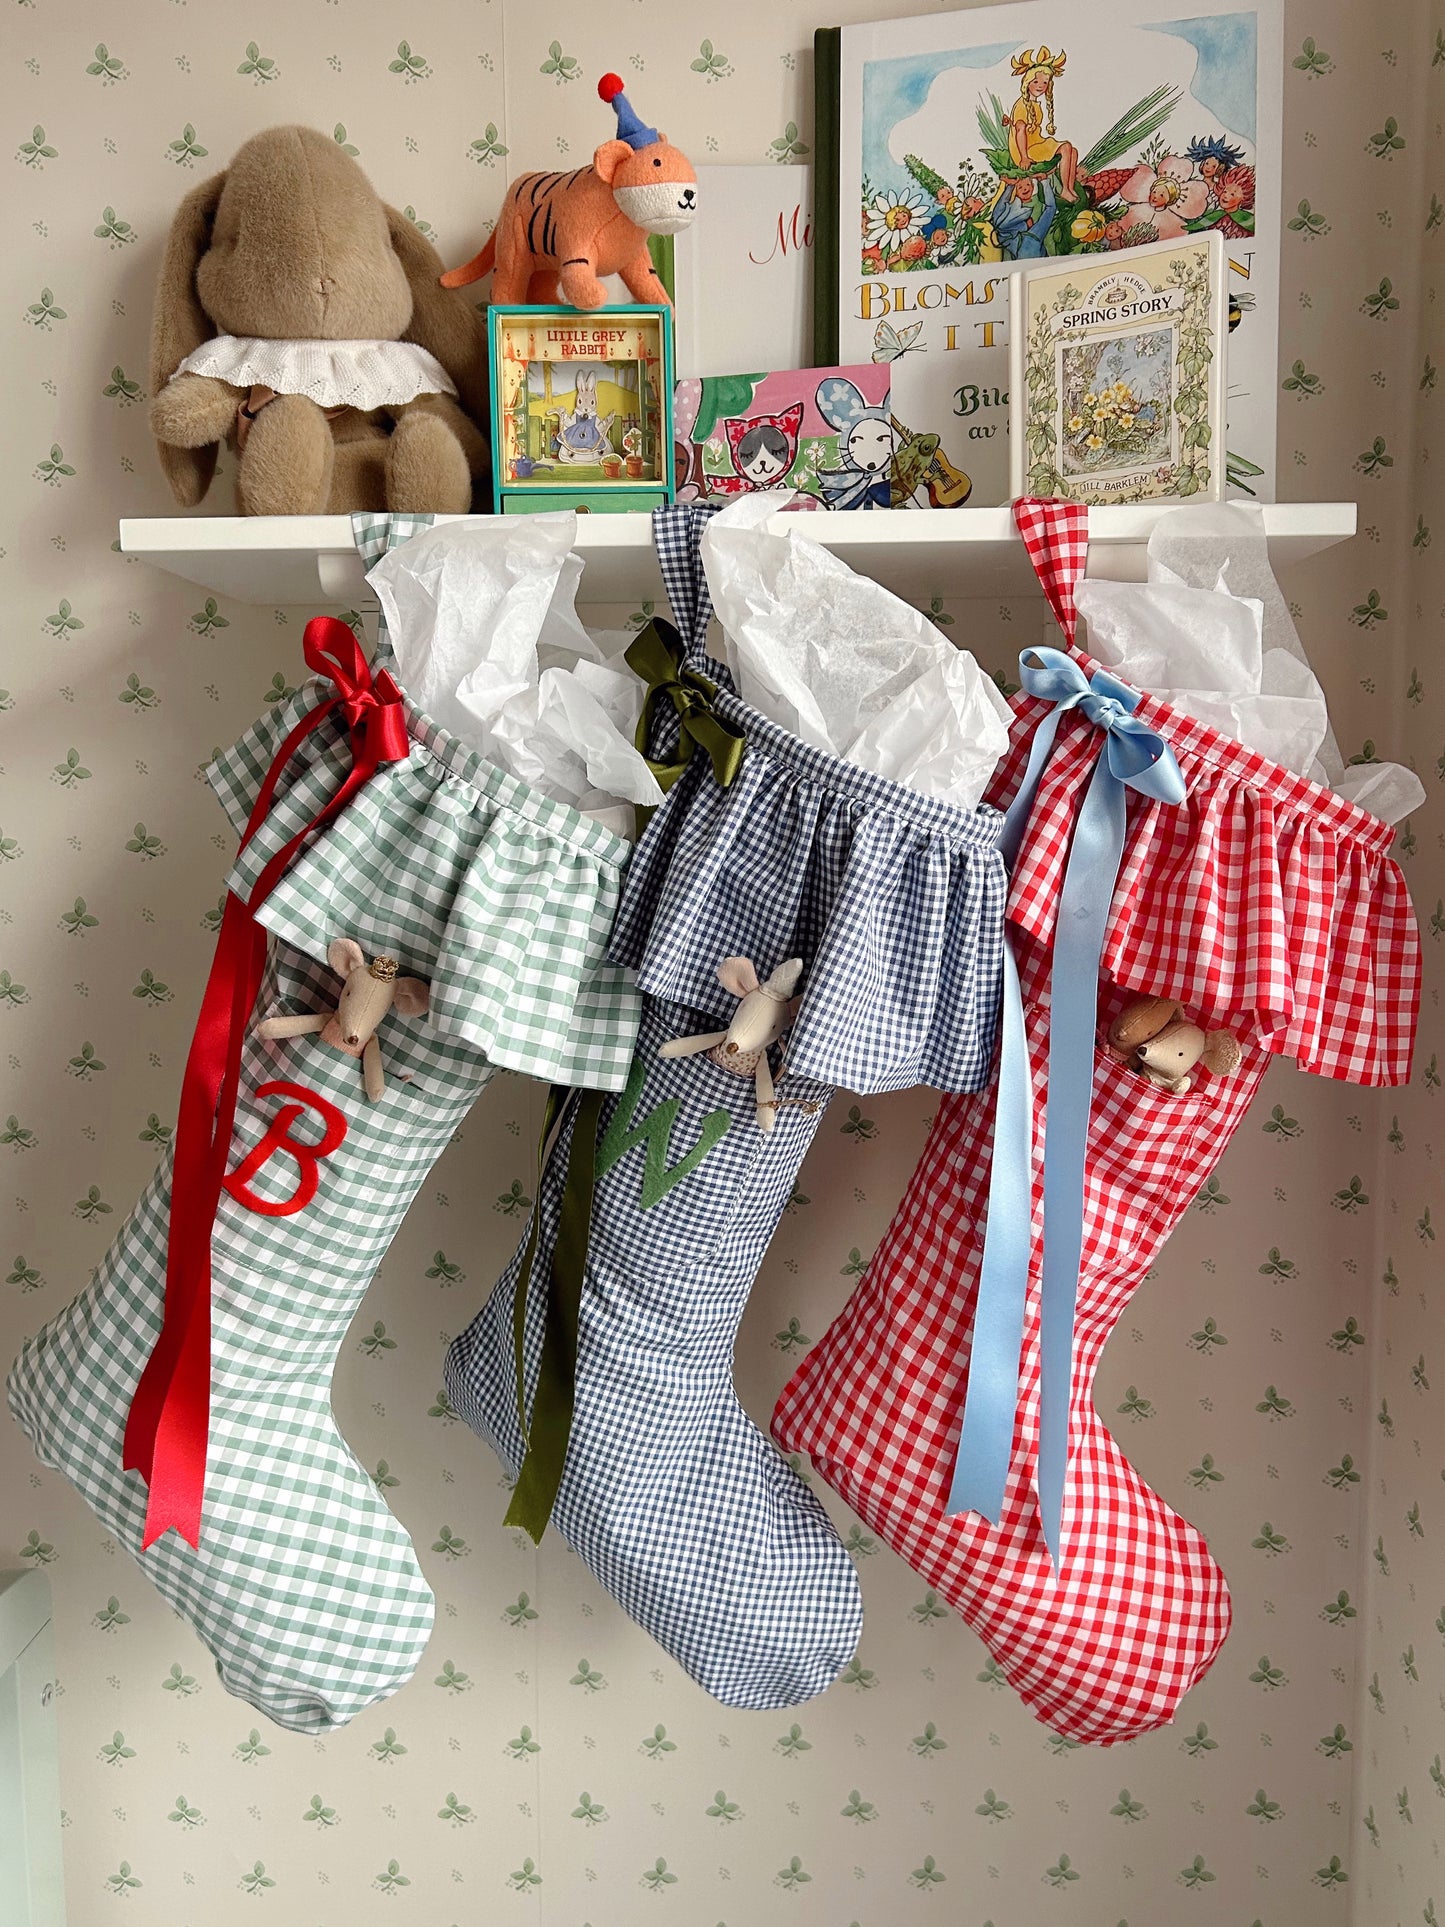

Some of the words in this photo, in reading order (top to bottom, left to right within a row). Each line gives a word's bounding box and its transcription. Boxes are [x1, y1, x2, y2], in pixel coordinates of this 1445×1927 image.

[1088, 277, 1116, 305] BRAMBLY
[1123, 276, 1146, 294] HEDGE
[1062, 308, 1117, 328] SPRING
[1121, 296, 1172, 318] STORY
[547, 330, 588, 342] LITTLE
[592, 330, 627, 342] GREY
[943, 325, 960, 350] I
[974, 320, 1008, 347] T
[561, 344, 606, 355] RABBIT
[968, 425, 998, 439] av
[1082, 482, 1101, 492] JILL
[1104, 475, 1148, 491] BARKLEM
[222, 1080, 348, 1217] B
